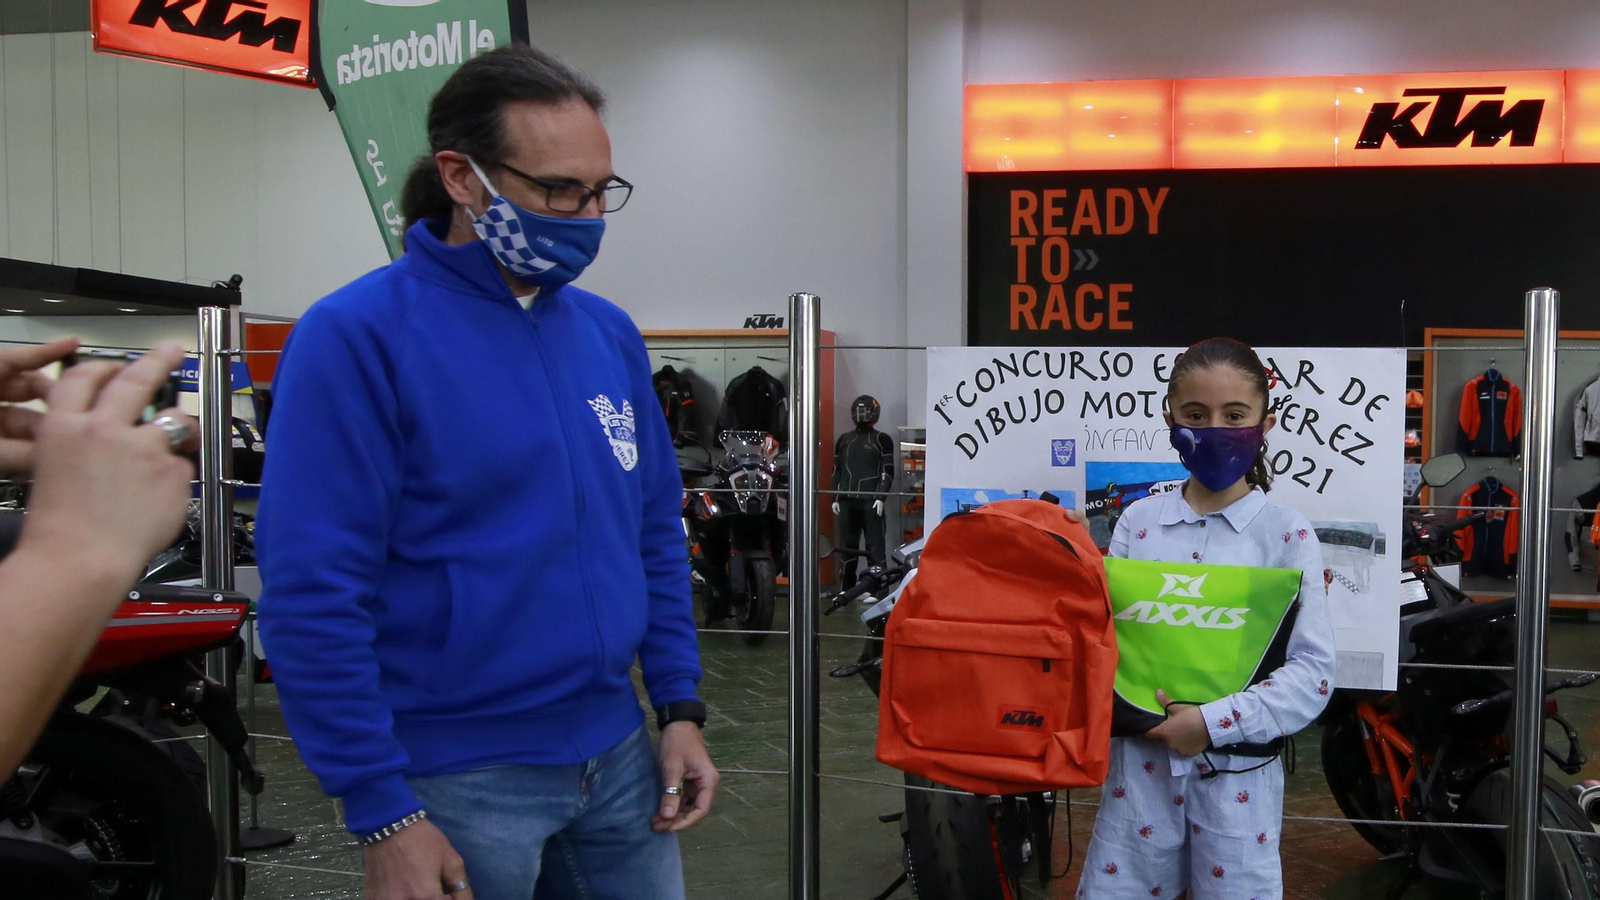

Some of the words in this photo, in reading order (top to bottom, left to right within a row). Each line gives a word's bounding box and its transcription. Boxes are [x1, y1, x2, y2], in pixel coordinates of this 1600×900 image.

[128, 0, 302, 54] KTM
[1354, 86, 1546, 149] KTM
[1010, 187, 1170, 236] READY
[1010, 236, 1070, 284] TO
[743, 313, 784, 329] KTM
[1010, 283, 1134, 331] RACE
[955, 349, 1134, 408] CONCURSO
[1338, 376, 1390, 422] DE
[954, 388, 1065, 461] DIBUJO
[1271, 449, 1334, 494] 021
[1113, 601, 1251, 630] AXXIS
[1000, 709, 1044, 728] KTM
